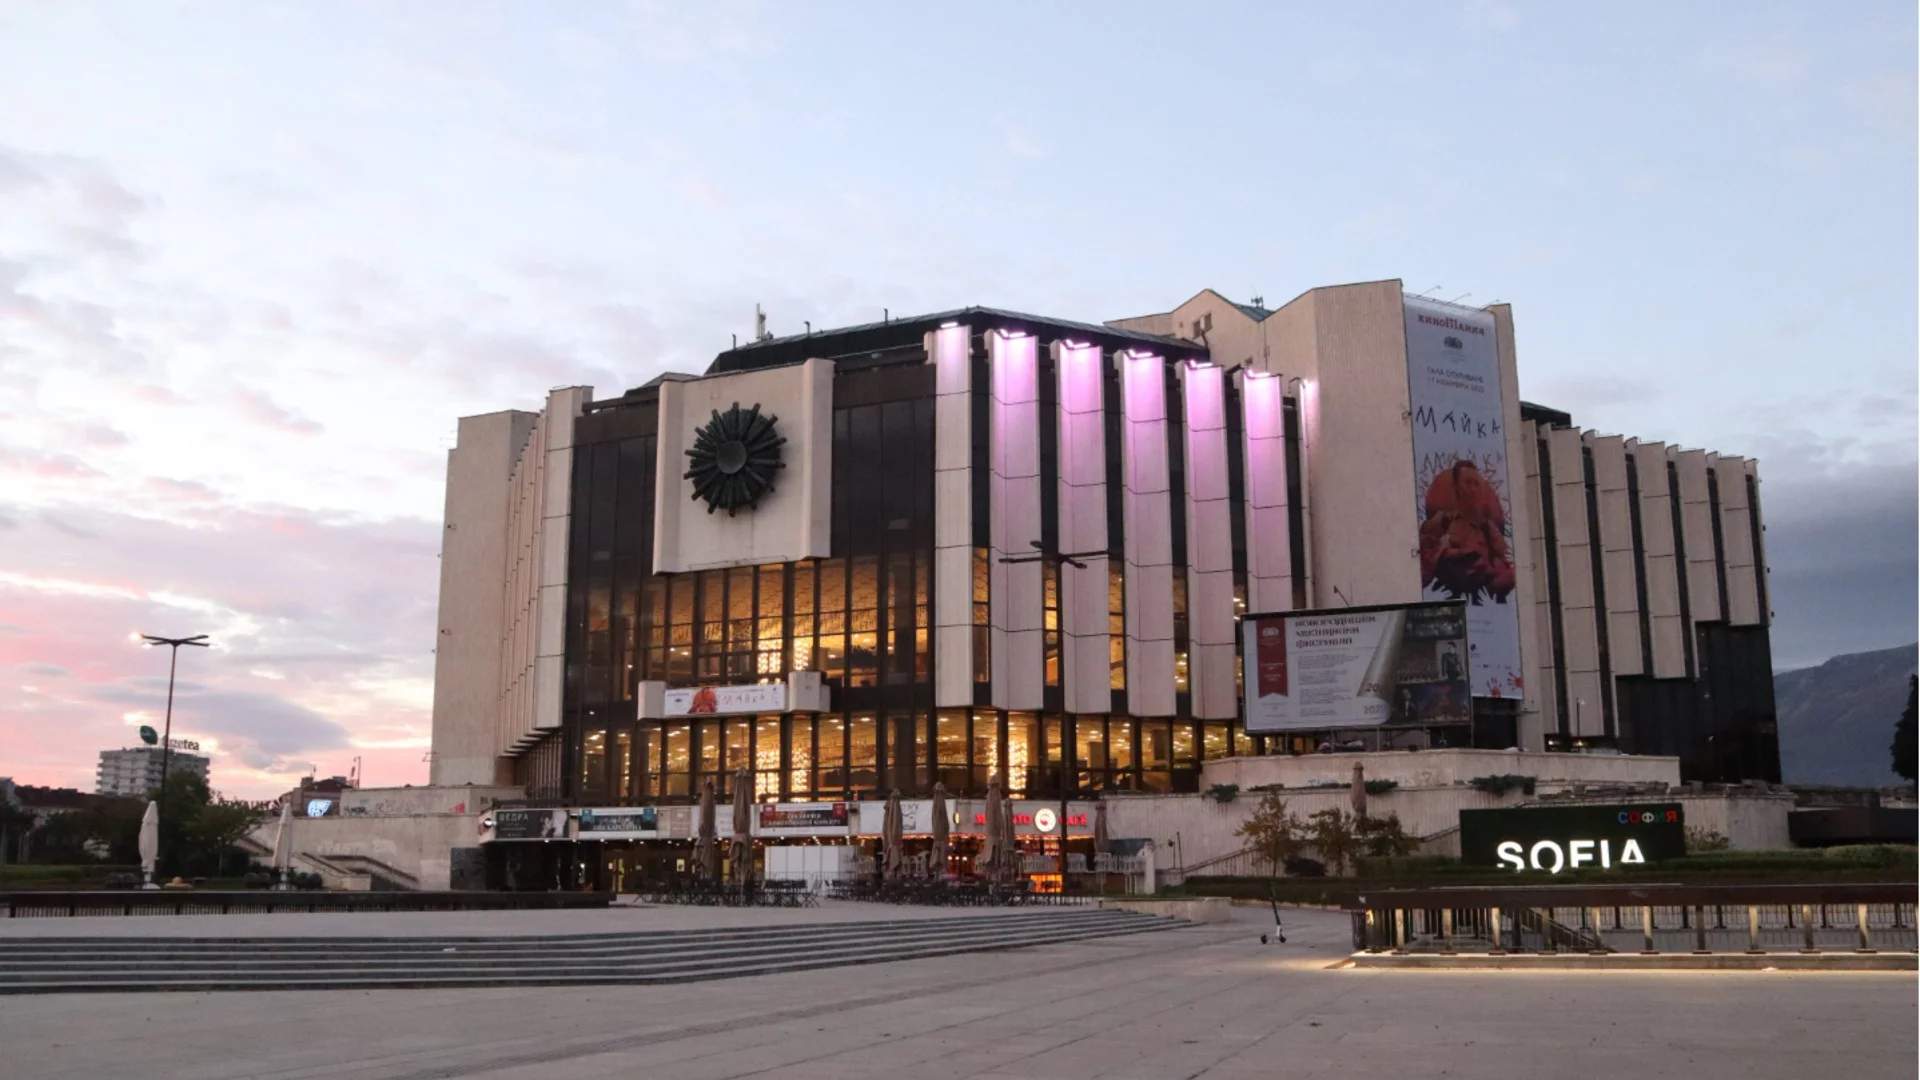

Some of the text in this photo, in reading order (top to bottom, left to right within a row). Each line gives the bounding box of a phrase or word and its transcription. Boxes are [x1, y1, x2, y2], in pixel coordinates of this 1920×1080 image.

[1416, 404, 1502, 438] МАЙКА
[1617, 809, 1678, 824] СОФИЯ
[1496, 838, 1645, 875] SOFIA
